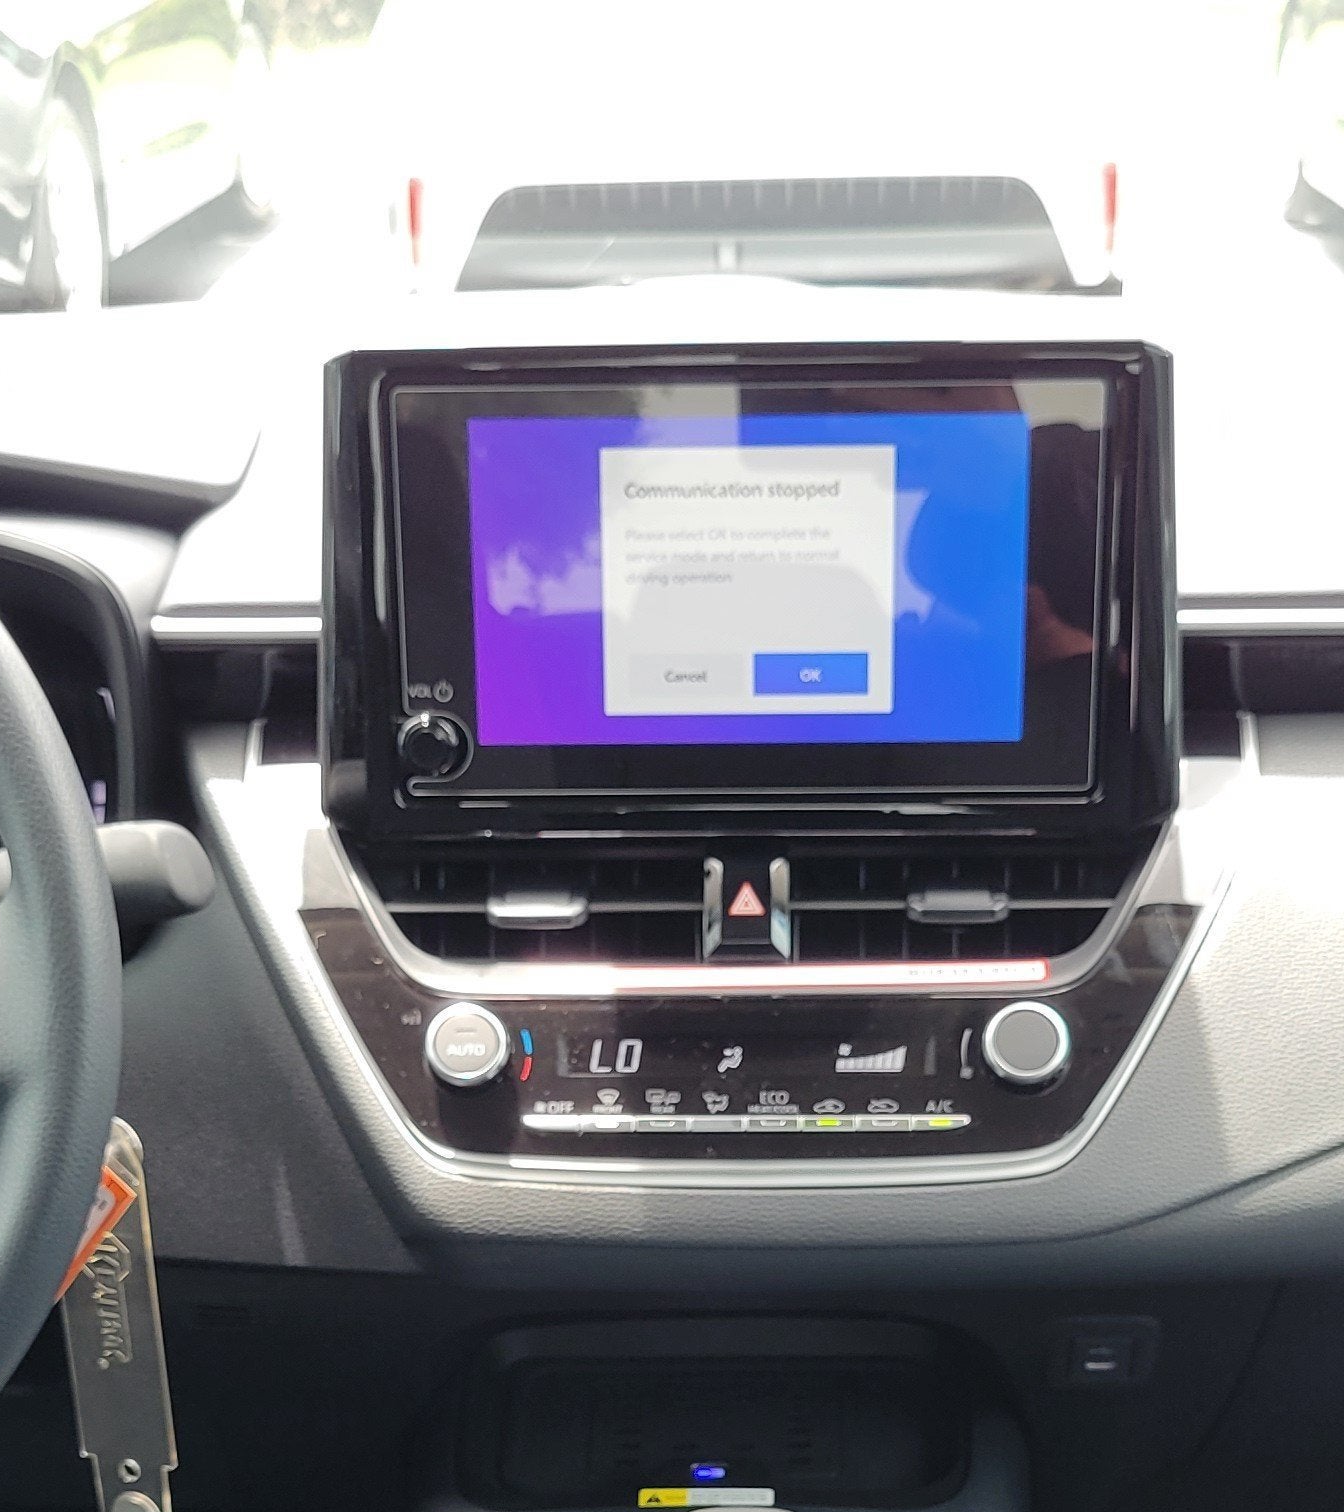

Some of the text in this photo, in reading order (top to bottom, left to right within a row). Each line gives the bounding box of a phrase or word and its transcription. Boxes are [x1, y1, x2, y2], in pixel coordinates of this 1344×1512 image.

[624, 479, 842, 501] Communication stopped
[664, 669, 708, 683] Cancel
[799, 668, 823, 683] OK
[446, 1043, 486, 1056] AUTO
[759, 1089, 790, 1105] ECO
[548, 1100, 575, 1114] OFF
[925, 1099, 955, 1114] A/C
